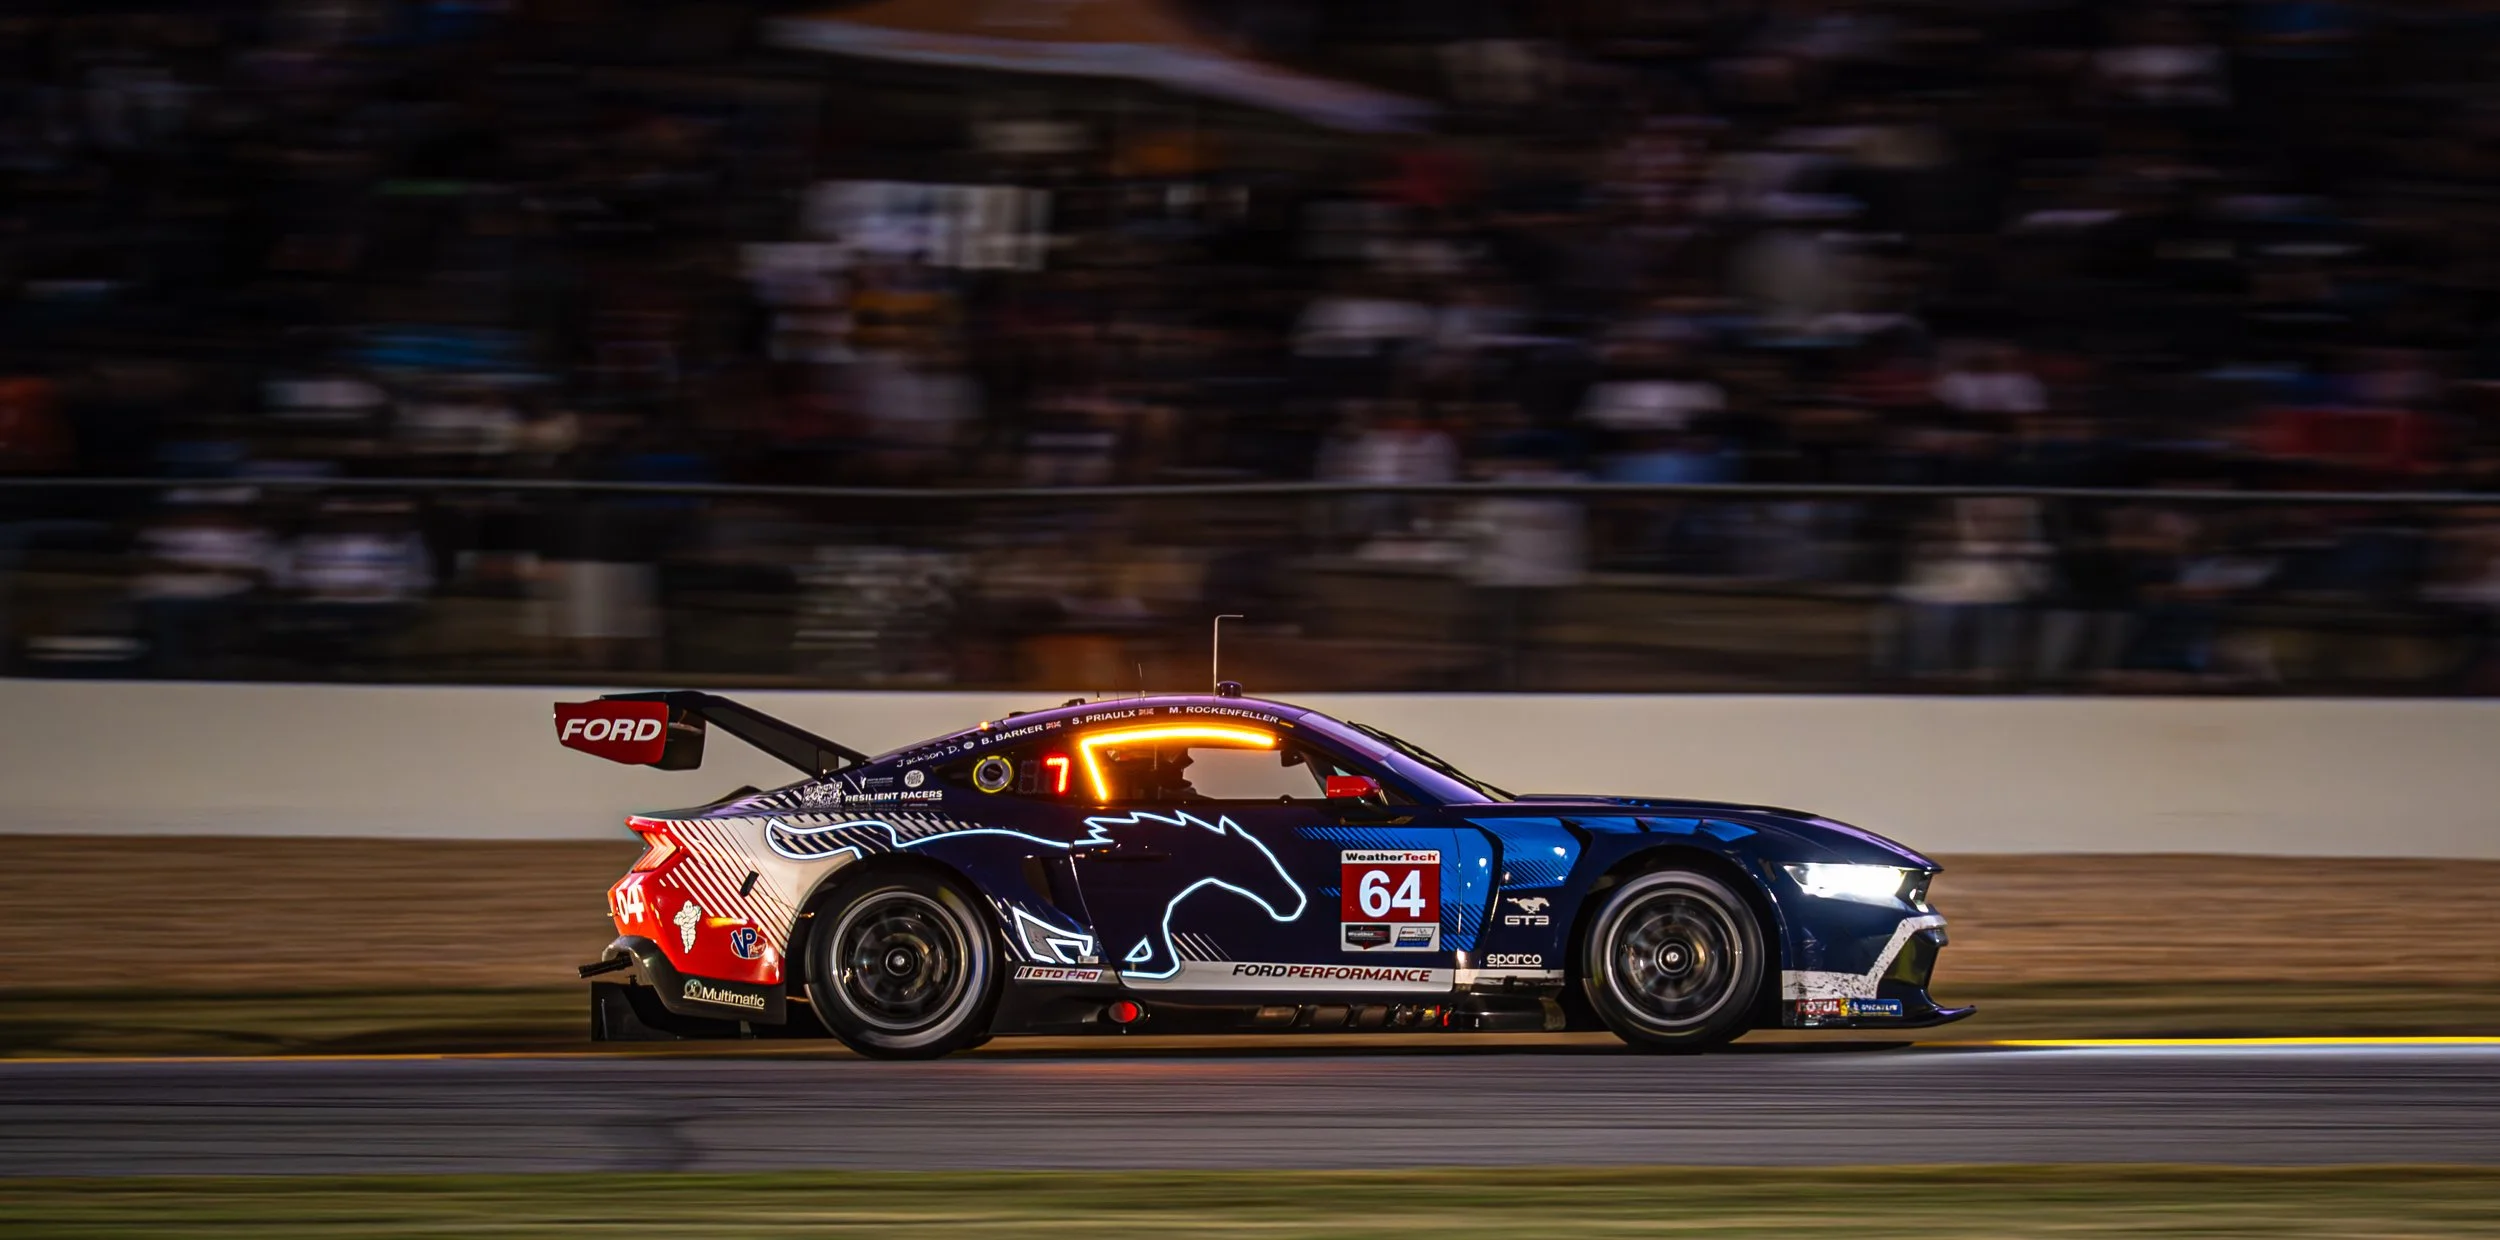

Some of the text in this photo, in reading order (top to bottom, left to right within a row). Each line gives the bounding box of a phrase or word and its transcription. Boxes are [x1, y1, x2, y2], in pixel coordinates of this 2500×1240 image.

[1072, 710, 1136, 725] S. PRIAULX
[1186, 706, 1279, 724] ROCKENFELLER
[561, 719, 662, 741] FORD
[981, 724, 1043, 745] B. BARKER
[897, 745, 960, 768] Jackson D.
[1045, 755, 1070, 794] 7
[845, 790, 942, 802] RESILIENT RACERS
[1345, 852, 1437, 861] WeatherTech
[1359, 870, 1426, 918] 64
[1504, 915, 1549, 926] GT3
[731, 927, 757, 959] VP
[1486, 954, 1542, 968] sparco
[1032, 968, 1098, 980] GTD PRO
[702, 987, 765, 1006] Multimatic
